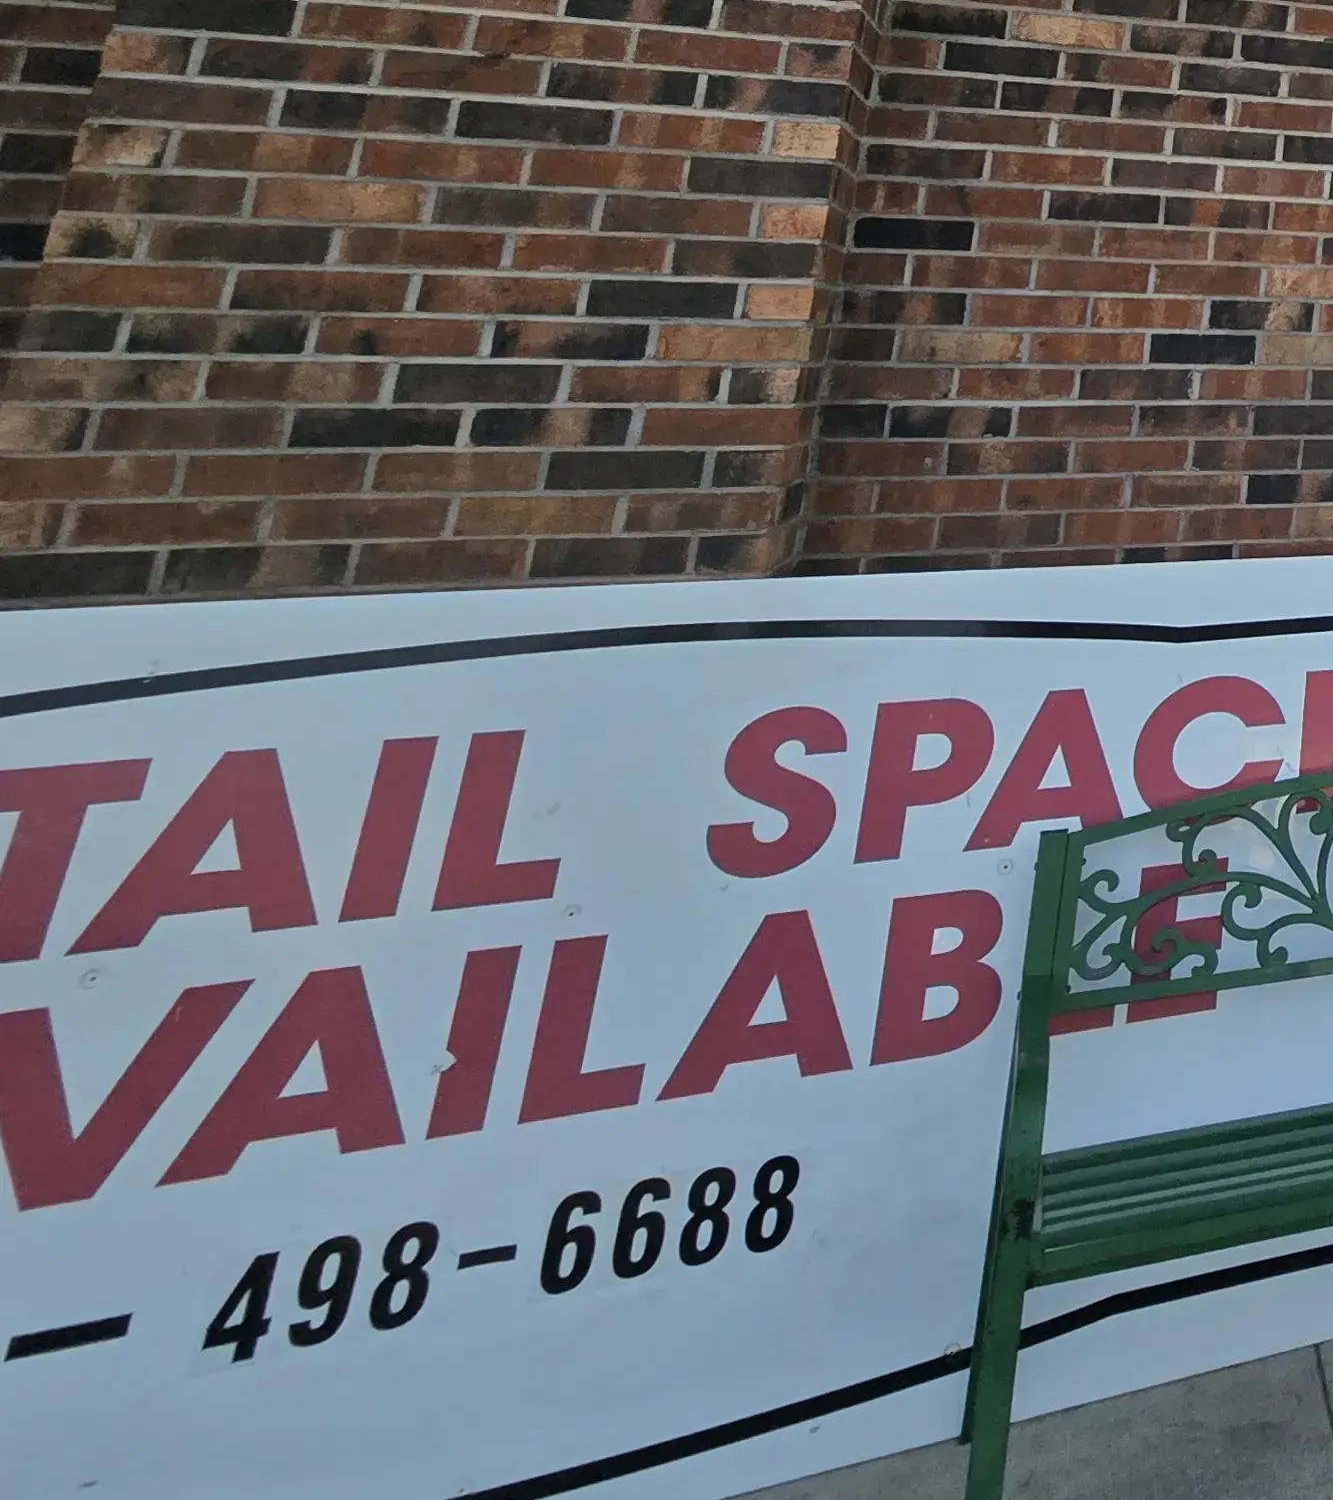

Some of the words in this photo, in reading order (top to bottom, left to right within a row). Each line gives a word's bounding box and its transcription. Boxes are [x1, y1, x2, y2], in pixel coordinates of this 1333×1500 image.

[0, 729, 560, 963] TAIL
[0, 857, 1230, 1212] VAILABE
[201, 1154, 803, 1364] 498-6688
